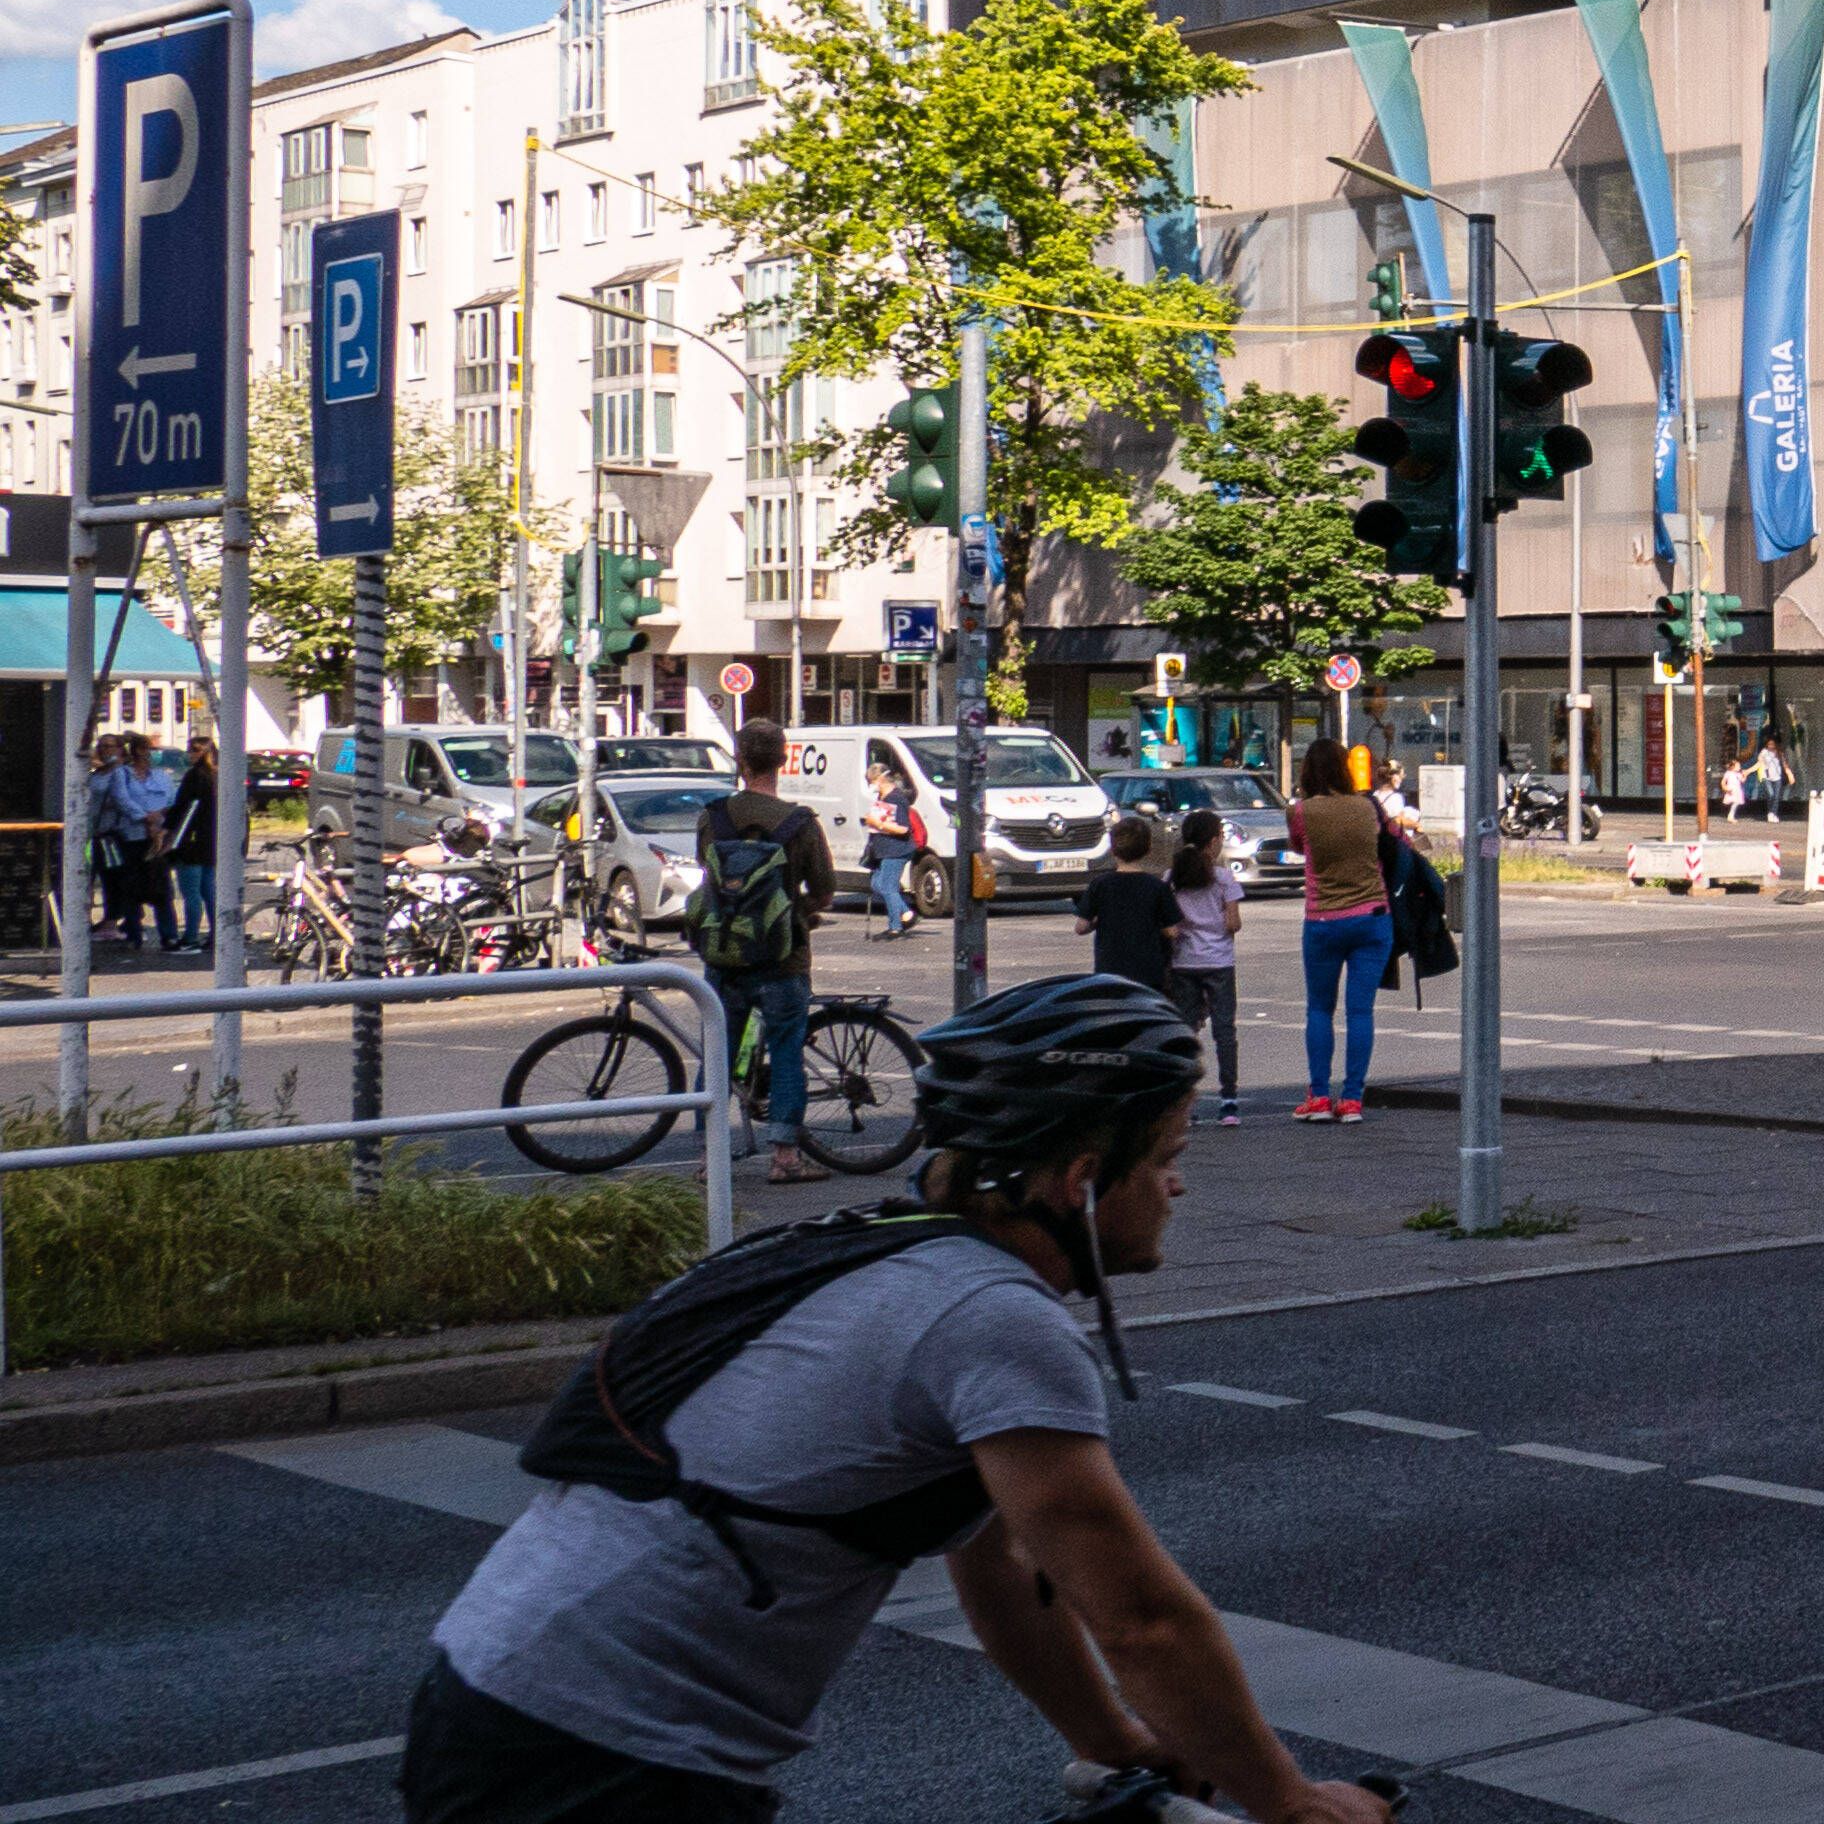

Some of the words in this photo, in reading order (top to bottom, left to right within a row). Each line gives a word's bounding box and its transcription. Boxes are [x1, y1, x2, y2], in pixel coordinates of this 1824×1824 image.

[123, 73, 200, 328] P
[332, 277, 364, 384] P
[113, 402, 158, 467] 70
[167, 409, 202, 462] m
[1770, 339, 1799, 473] GALERIA
[894, 614, 912, 639] P
[1004, 793, 1078, 808] MECo
